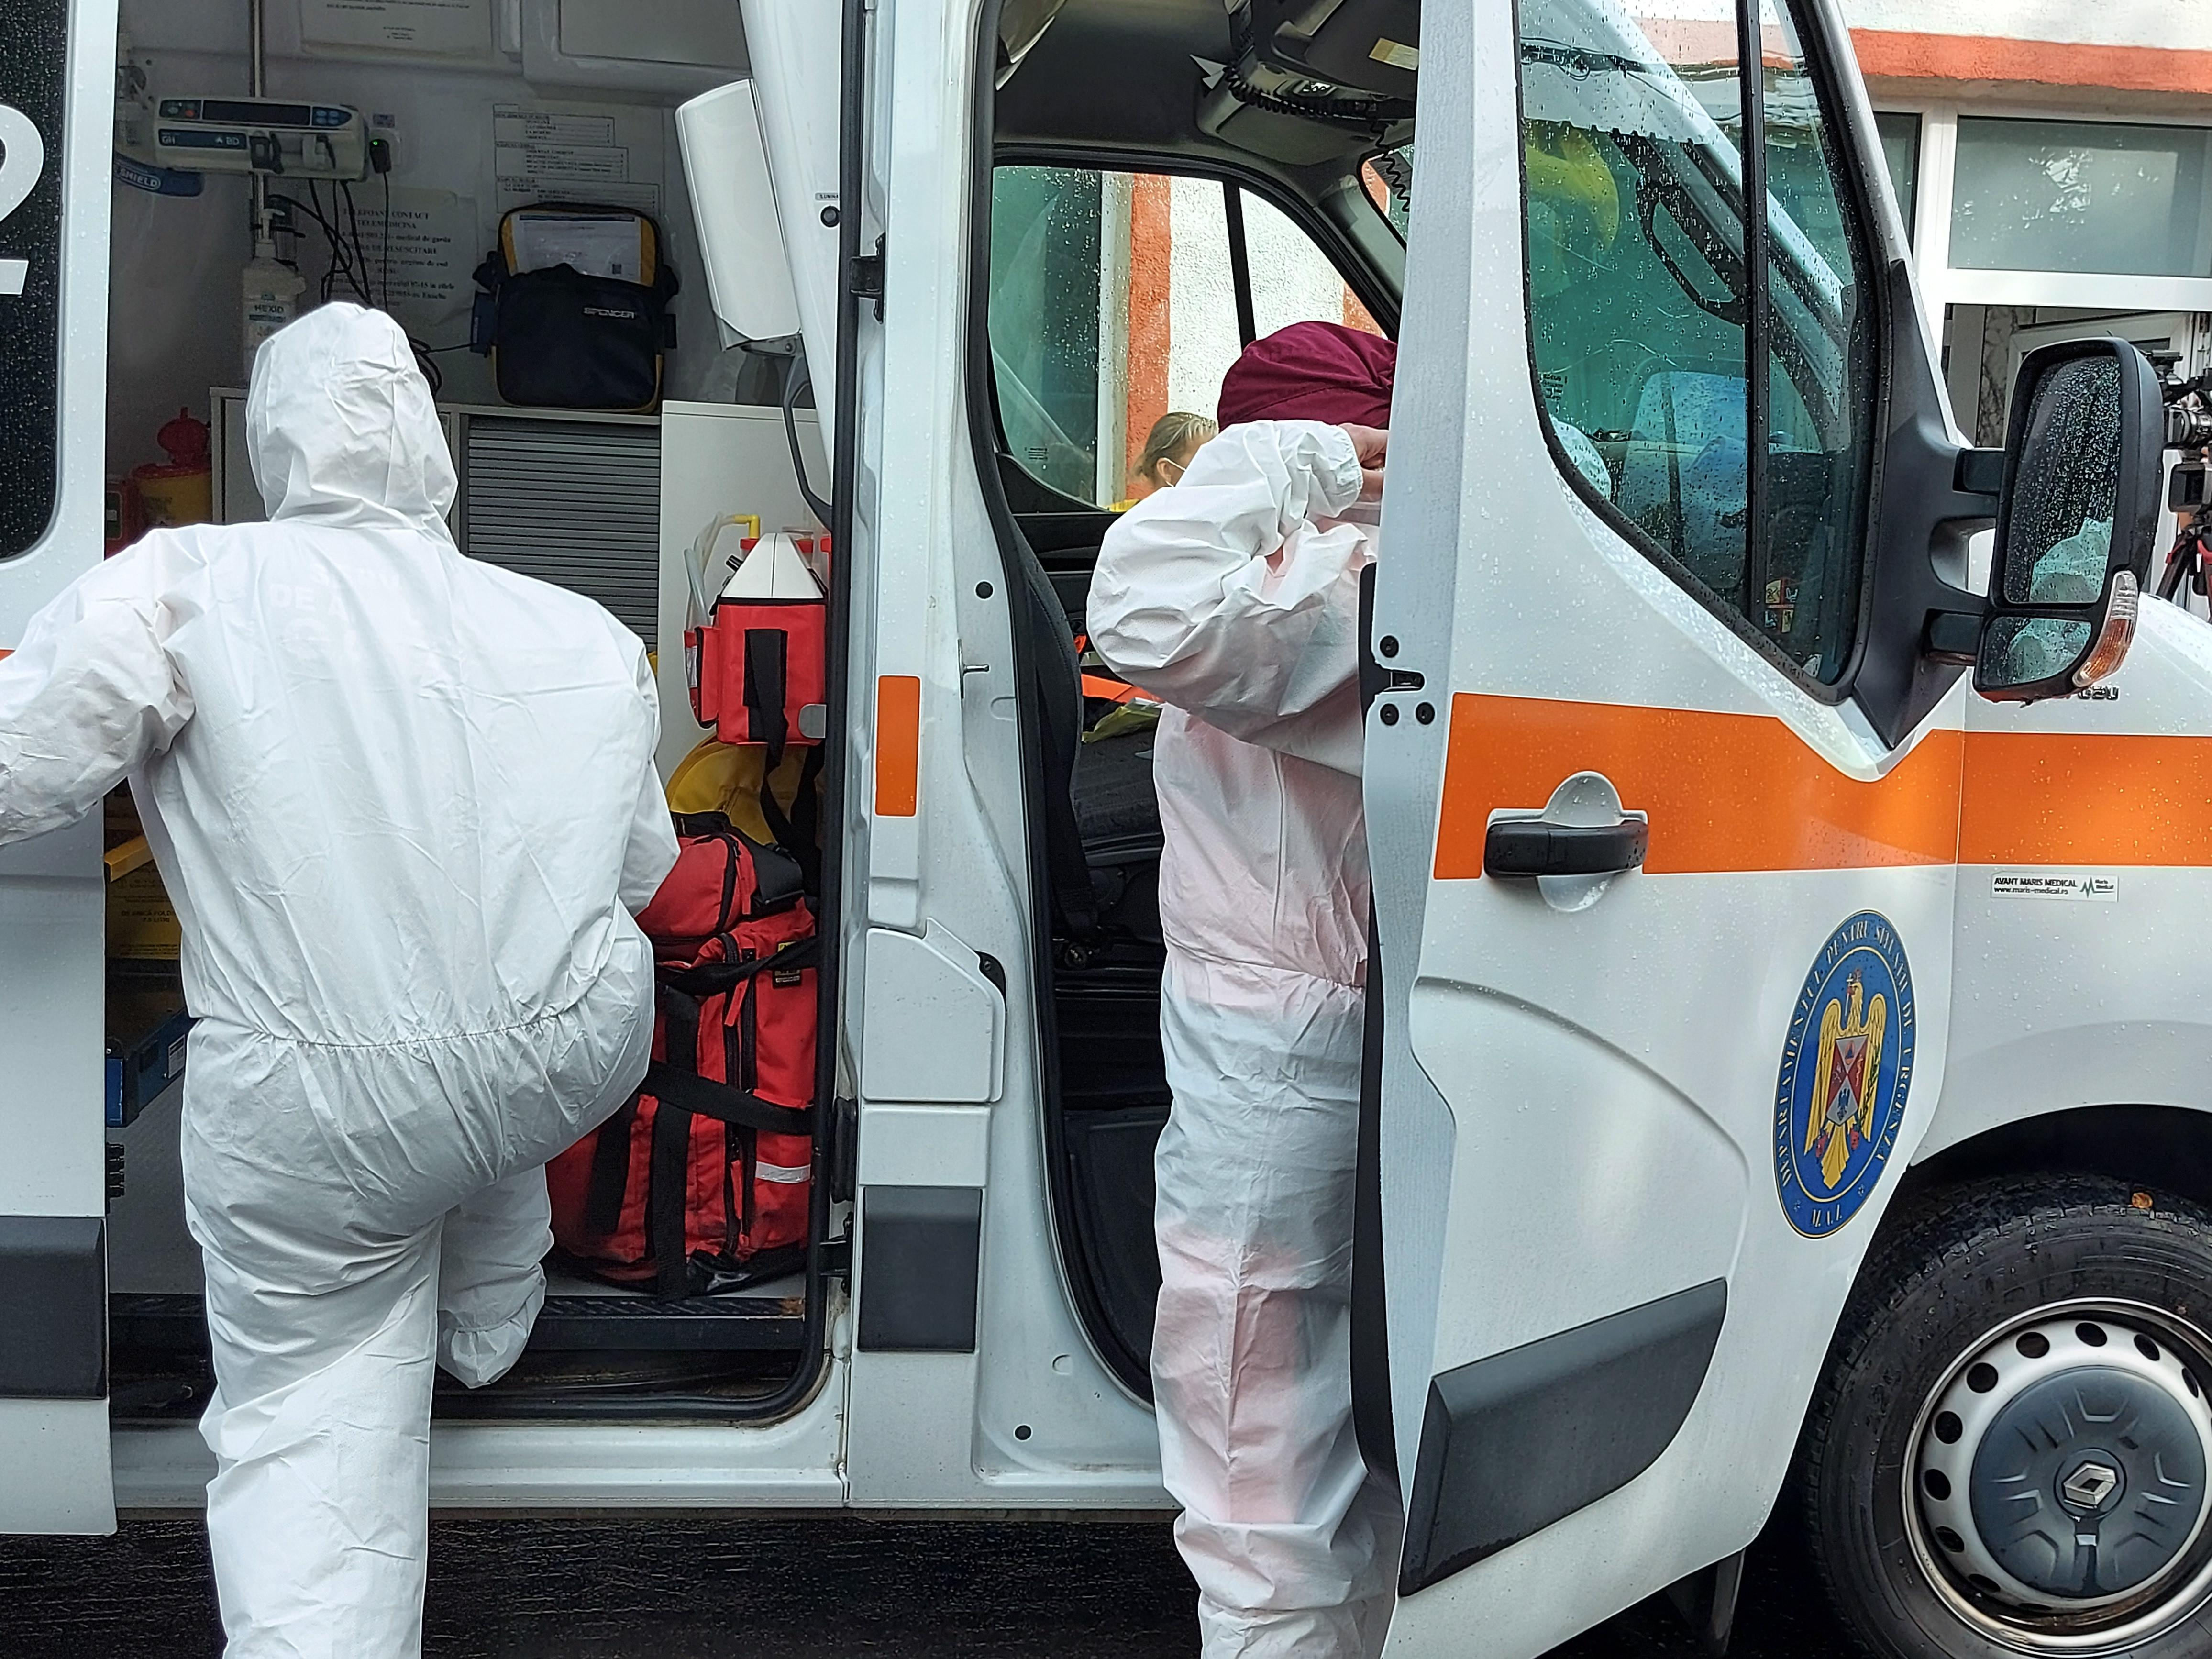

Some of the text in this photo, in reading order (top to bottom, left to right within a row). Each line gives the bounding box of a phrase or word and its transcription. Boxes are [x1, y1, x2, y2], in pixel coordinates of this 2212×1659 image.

[120, 168, 158, 187] SHIELD
[392, 212, 429, 220] CONTACT
[1994, 877, 2078, 888] AVANT MARIS MEDICAL
[1826, 920, 1870, 964] PENTRU
